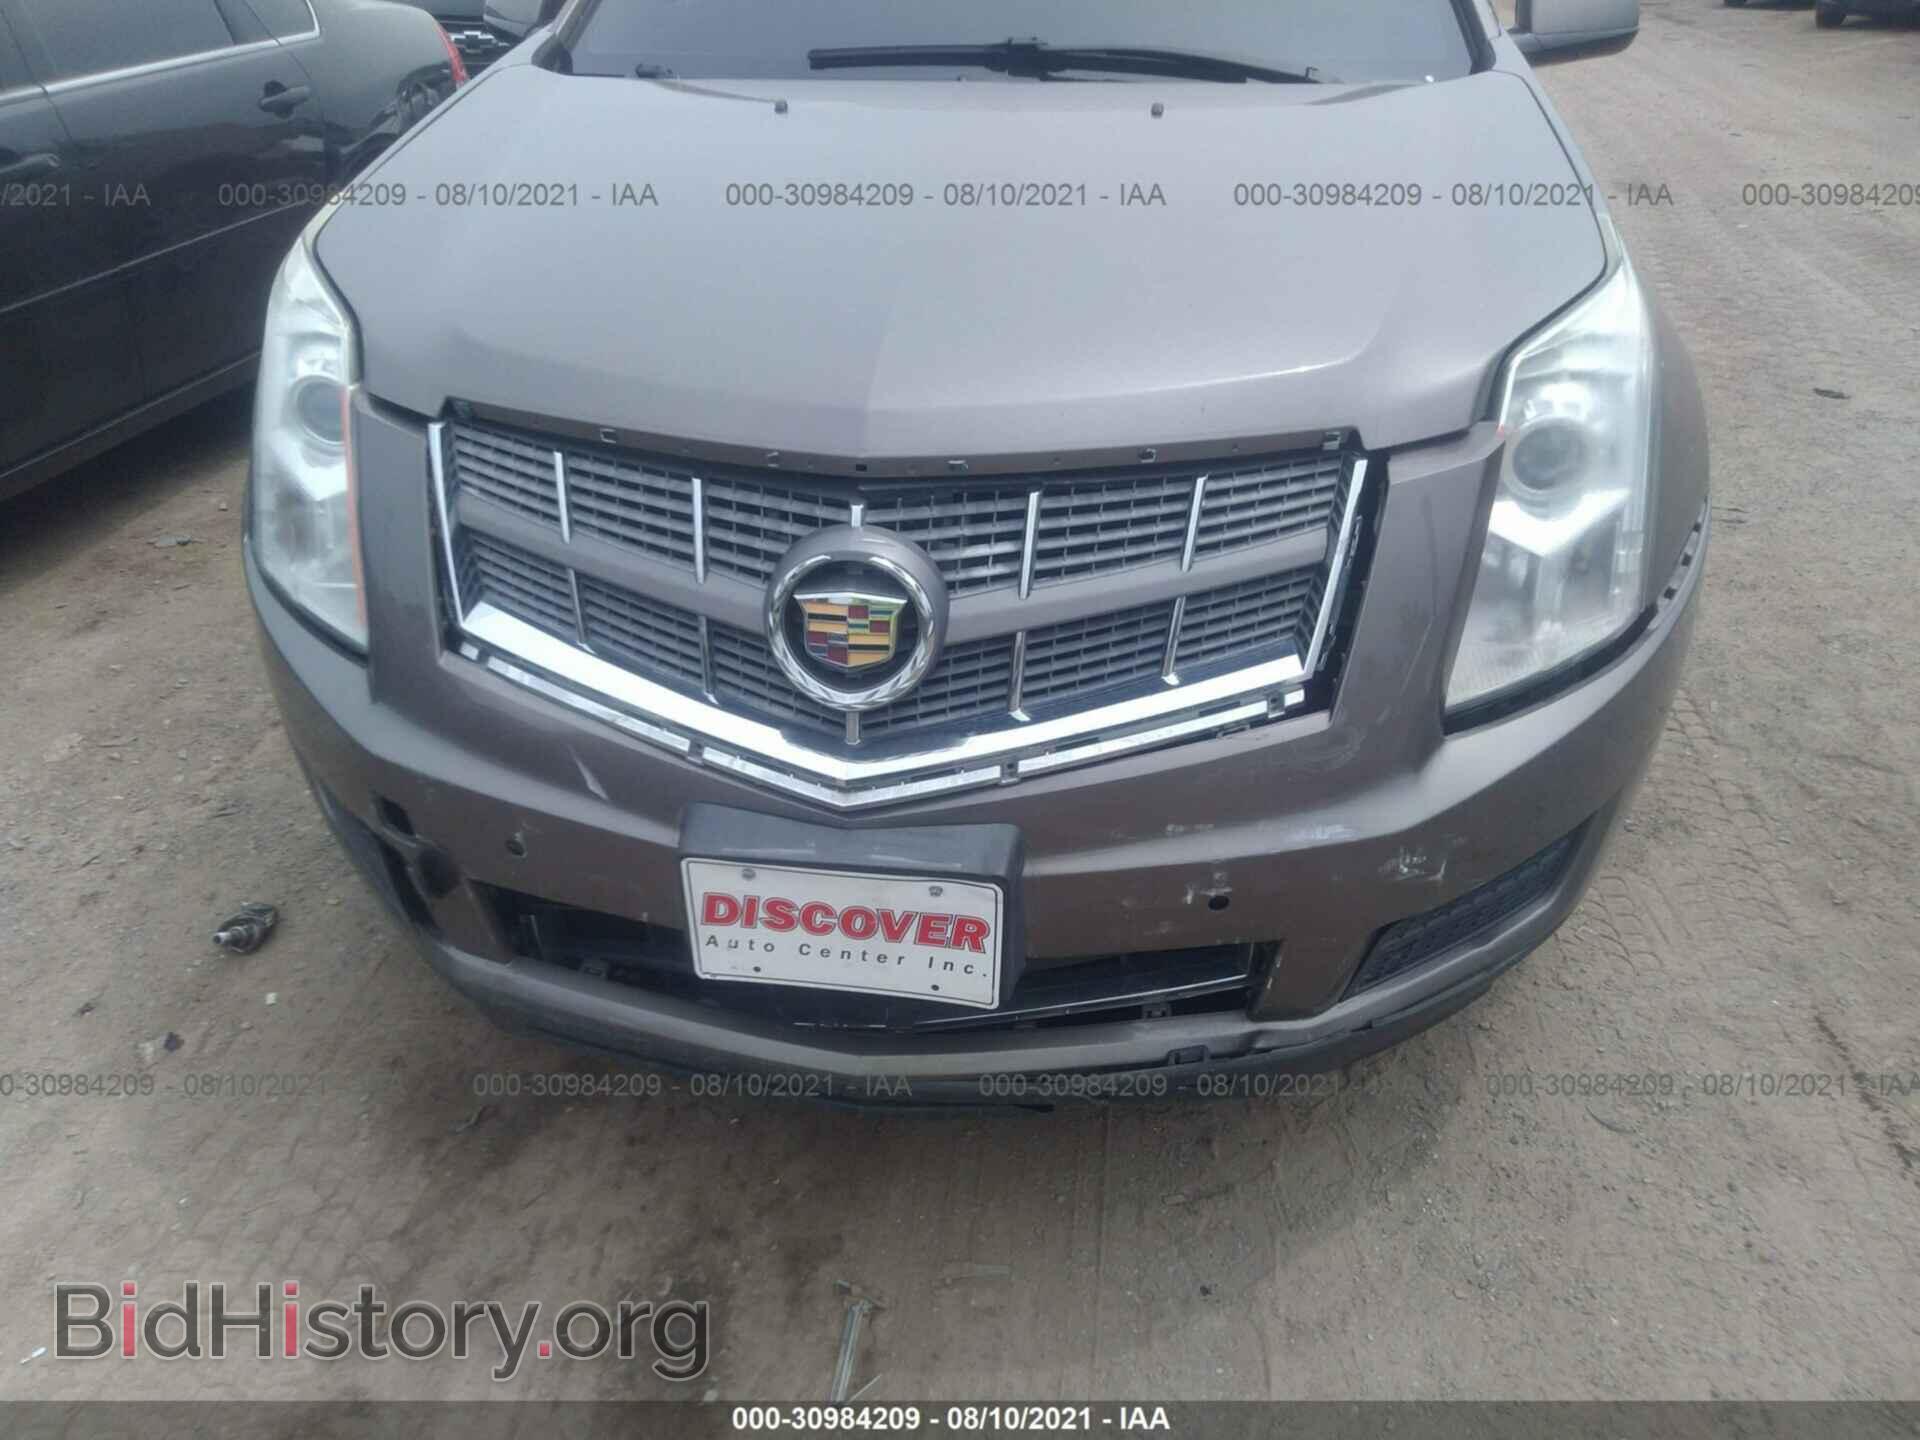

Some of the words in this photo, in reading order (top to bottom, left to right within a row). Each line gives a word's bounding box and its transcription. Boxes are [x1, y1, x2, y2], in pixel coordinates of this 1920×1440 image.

[702, 892, 990, 954] DISCOVER
[705, 934, 775, 953] Auto
[799, 943, 905, 966] Center
[928, 955, 988, 978] Inc.
